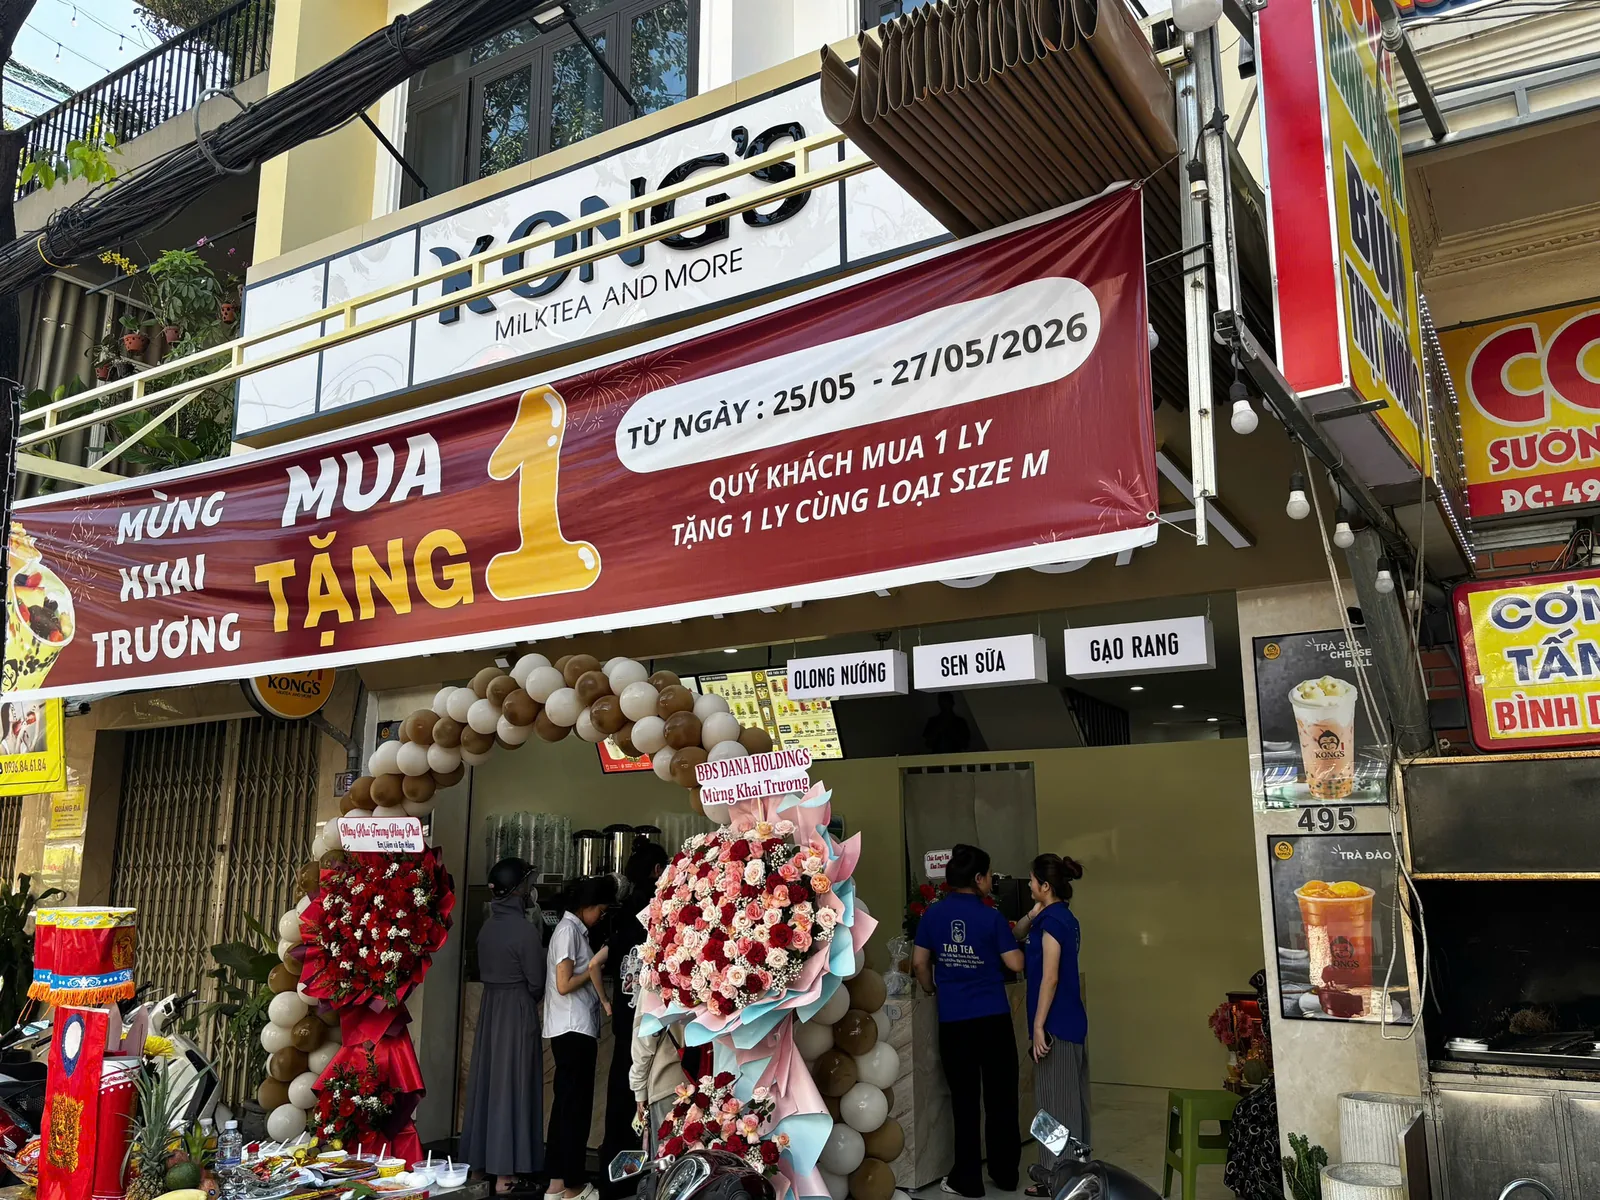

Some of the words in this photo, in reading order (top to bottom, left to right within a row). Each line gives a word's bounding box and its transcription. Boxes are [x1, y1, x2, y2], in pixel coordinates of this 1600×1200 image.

[429, 121, 812, 325] KONG'S
[602, 274, 658, 311] AND
[665, 247, 743, 291] MORE
[627, 418, 667, 451] TỪ
[673, 398, 751, 441] NGÀY
[756, 400, 765, 420] :
[773, 371, 856, 417] 25/05
[891, 311, 1088, 387] 27/05/2026
[708, 462, 760, 504] QUÝ
[766, 450, 853, 491] KHÁCH
[861, 434, 925, 471] MUA
[934, 430, 948, 455] 1
[957, 418, 993, 450] LY
[281, 432, 442, 528] MUA
[671, 513, 733, 551] TẶNG
[740, 509, 752, 535] 1
[760, 503, 790, 532] LY
[795, 484, 870, 525] CÙNG
[877, 472, 942, 508] LOẠI
[949, 456, 1013, 495] SIZE
[1020, 448, 1050, 478] M
[1501, 485, 1554, 513] ĐC:
[116, 488, 227, 546] MỪNG
[119, 552, 206, 603] KHAI
[254, 530, 475, 647] TẶNG
[91, 612, 241, 668] TRƯƠNG
[1089, 636, 1125, 665] GẠO
[1131, 632, 1180, 658] RANG
[1313, 640, 1336, 652] TRÀ
[794, 665, 836, 691] OLONG
[840, 660, 887, 687] NƯỚNG
[940, 654, 969, 678] SEN
[975, 647, 1006, 674] SỮA
[267, 675, 321, 696] KONG'S
[1495, 693, 1579, 731] BÌNH
[696, 762, 719, 782] BĐS
[720, 757, 752, 778] DANA
[752, 747, 811, 773] HOLDINGS
[702, 786, 735, 804] Mừng
[736, 780, 763, 799] Khai
[764, 777, 810, 794] Trương
[1297, 807, 1356, 832] 495
[1339, 850, 1361, 861] TRÀ
[1365, 849, 1392, 860] ĐÀO
[943, 943, 958, 953] TAB
[960, 944, 974, 955] TEA
[1333, 959, 1360, 969] ONG'S
